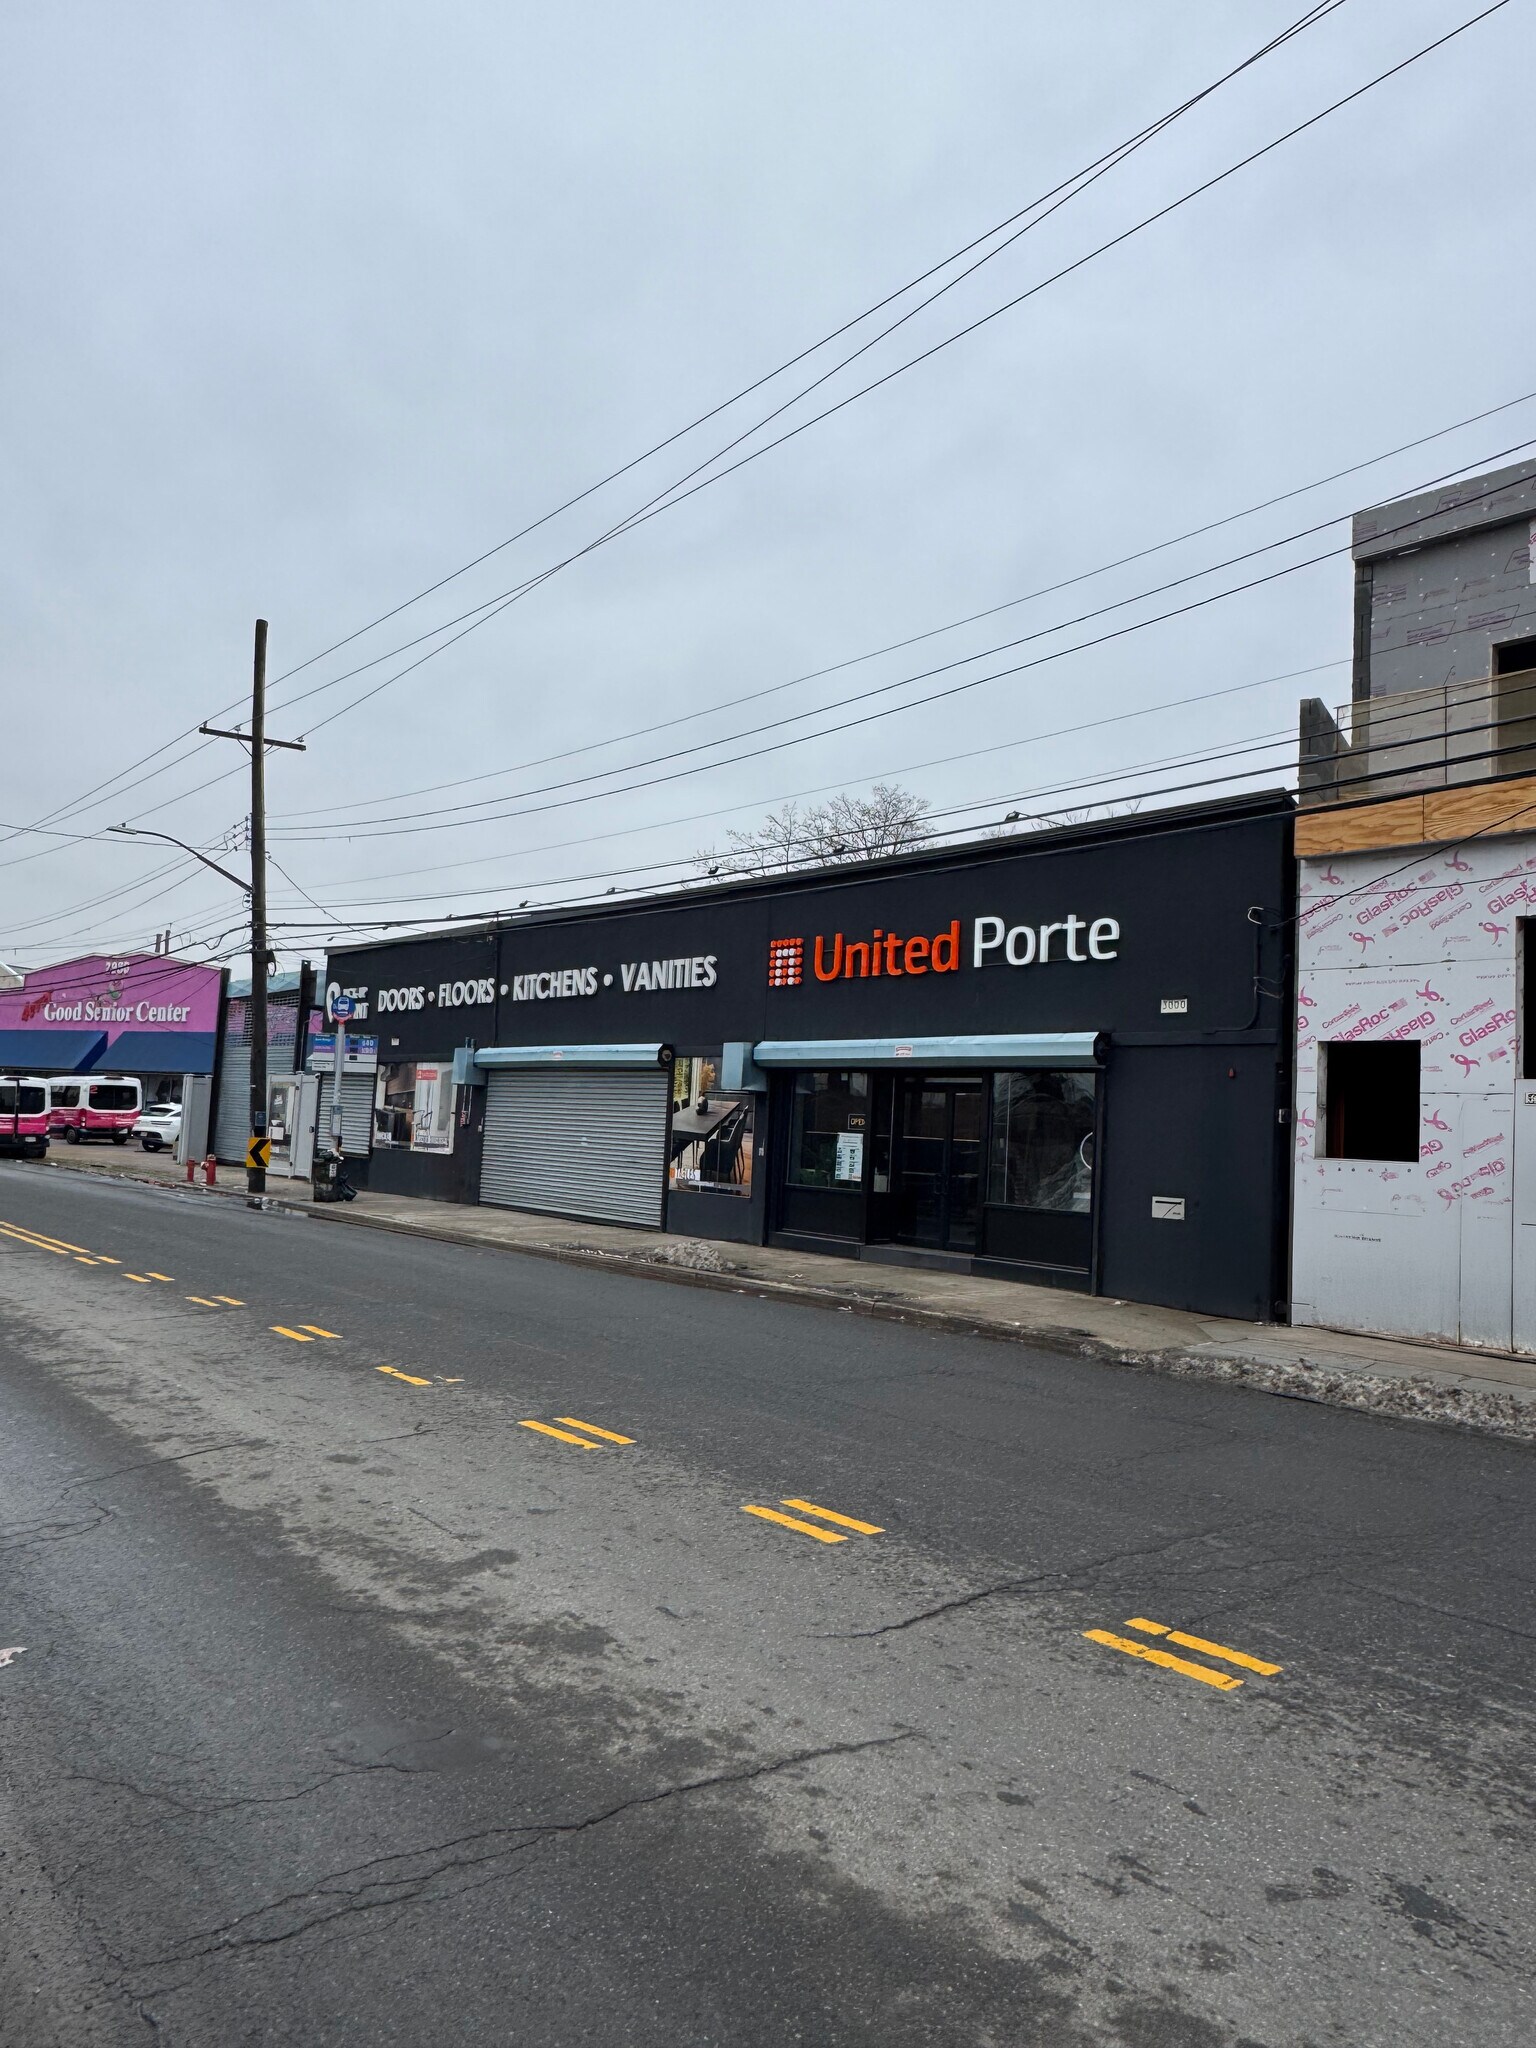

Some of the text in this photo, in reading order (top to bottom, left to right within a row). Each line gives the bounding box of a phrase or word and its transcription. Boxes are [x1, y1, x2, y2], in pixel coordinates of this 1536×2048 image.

[813, 914, 1120, 981] United Porte
[44, 1001, 82, 1022] Good
[84, 1001, 134, 1022] Senior
[136, 1001, 191, 1022] Center
[377, 986, 425, 1012] DOORS
[438, 977, 495, 1007] FLOORS
[512, 966, 598, 1001] KITCHENS
[621, 955, 718, 992] VANITIES
